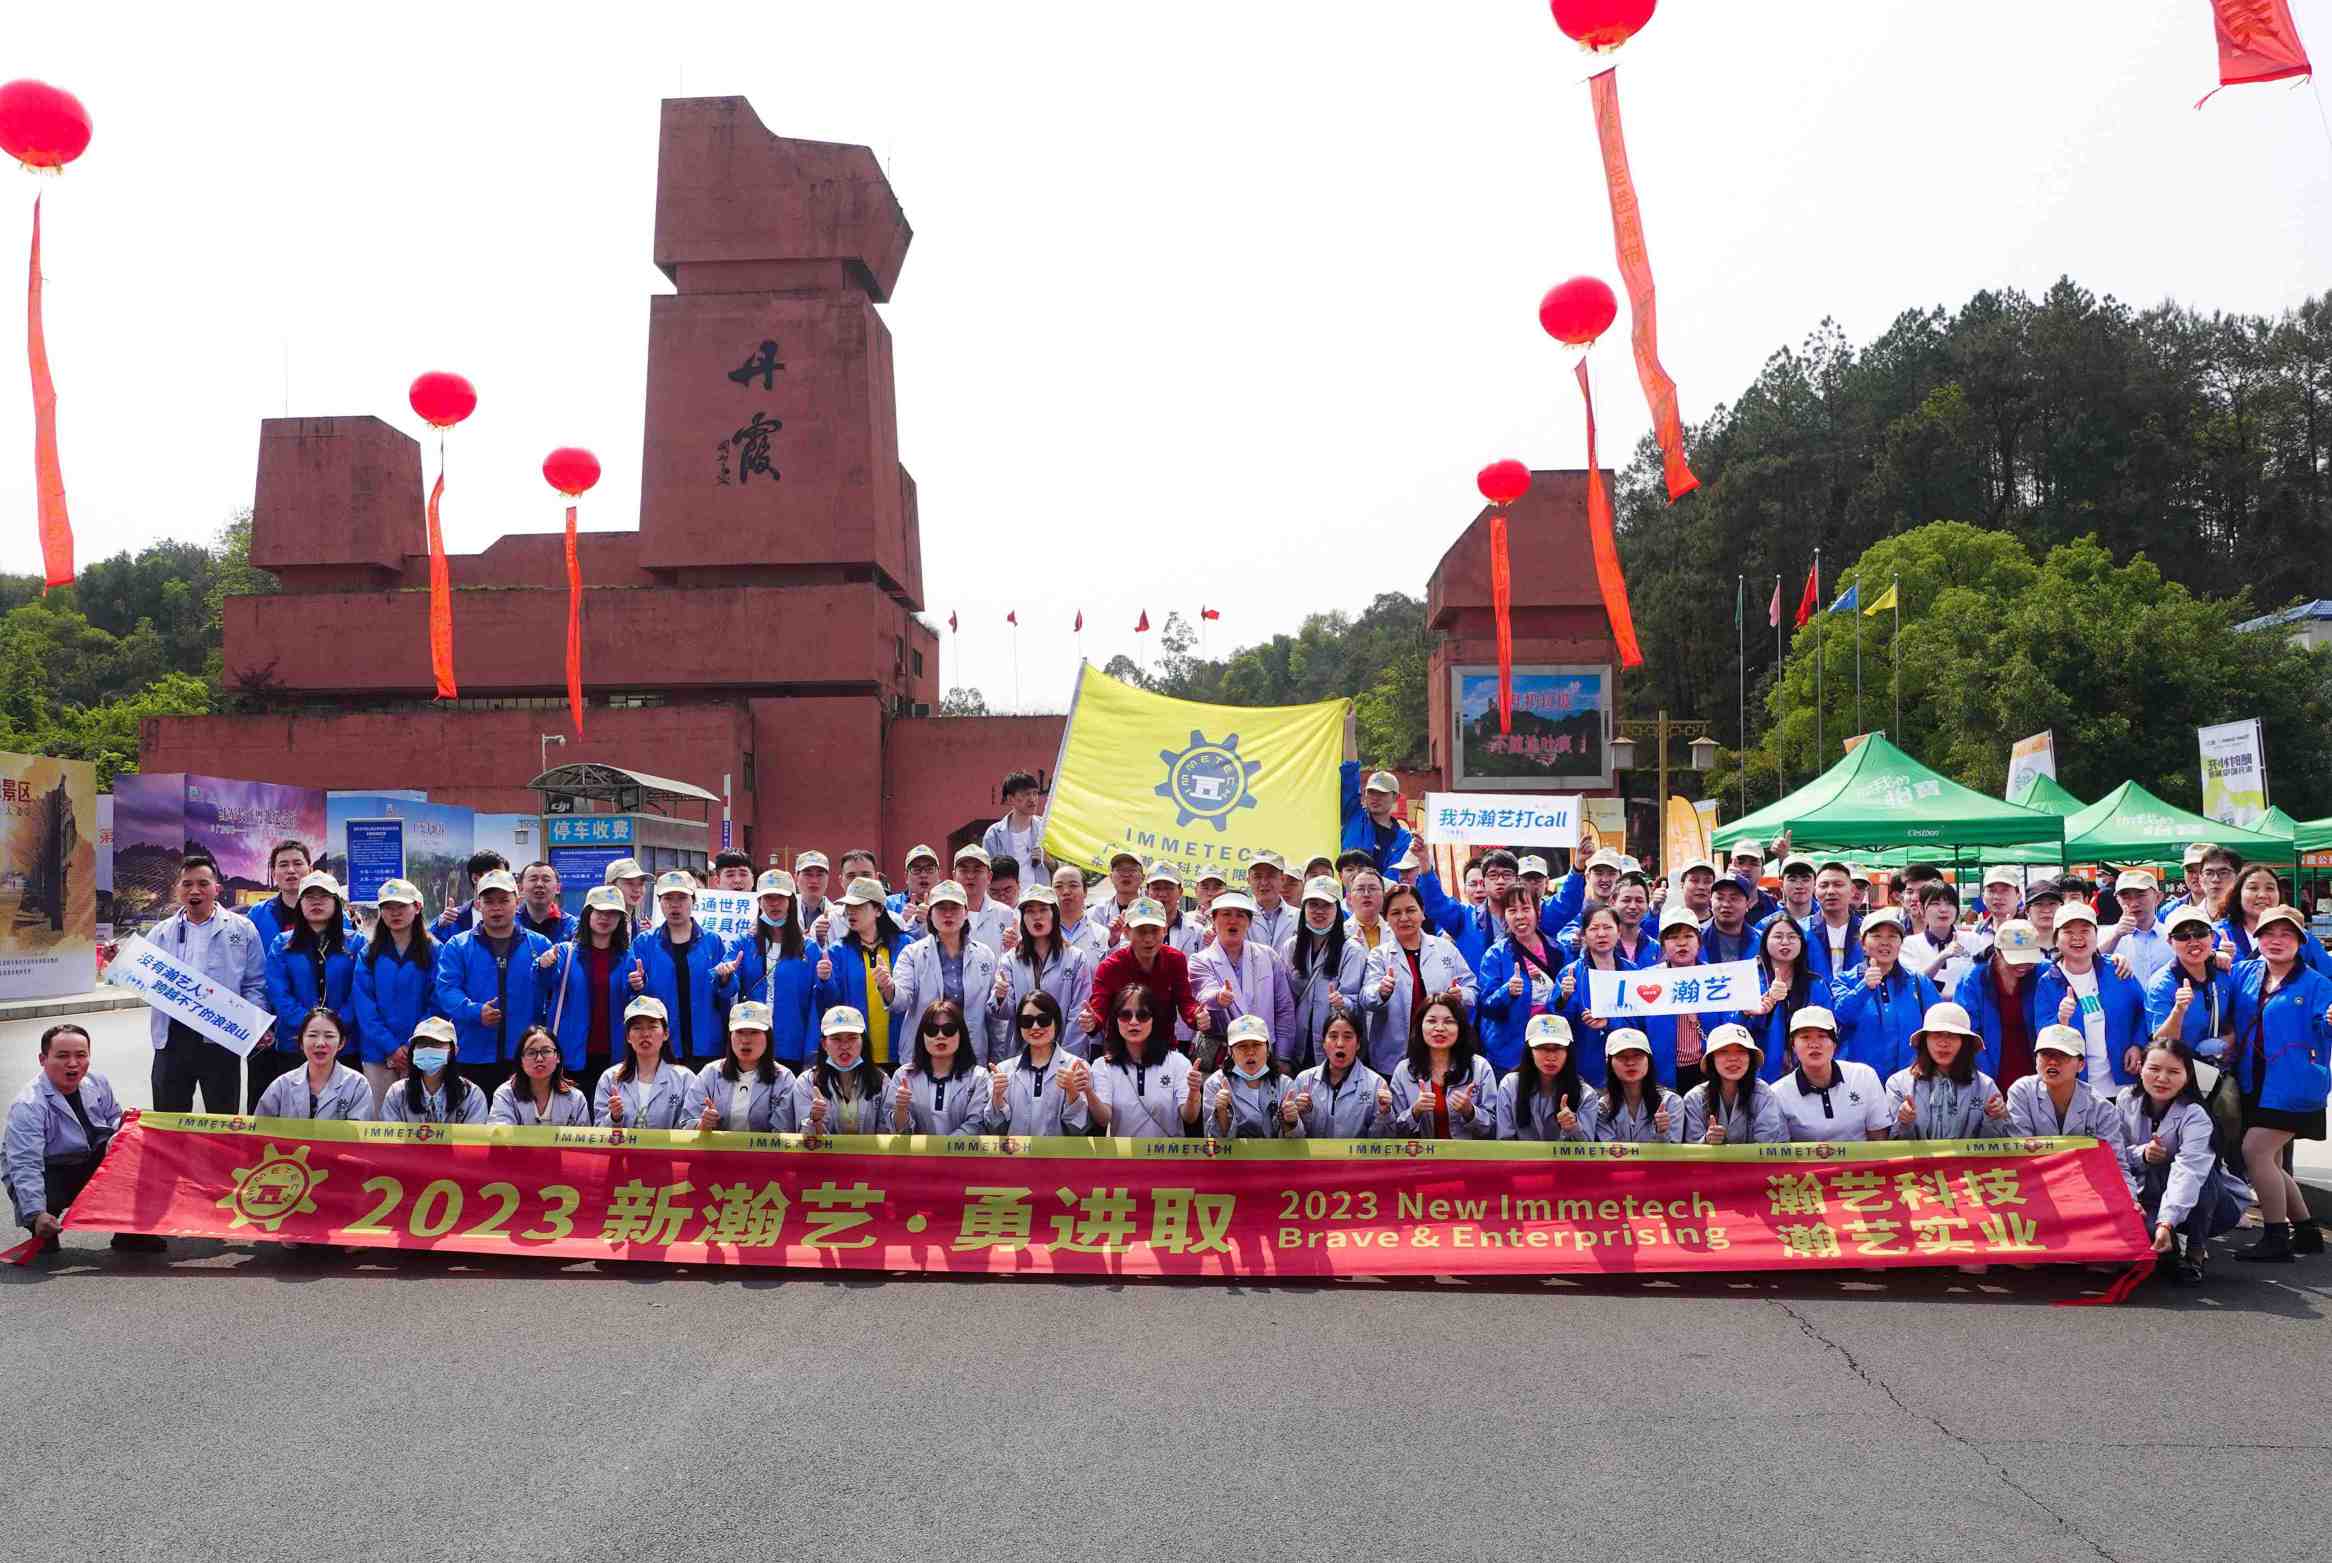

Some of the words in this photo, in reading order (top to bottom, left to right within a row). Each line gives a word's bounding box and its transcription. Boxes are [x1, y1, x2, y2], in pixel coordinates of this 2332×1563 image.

[0, 778, 32, 802] 景区
[554, 820, 629, 841] 停车收费
[1440, 807, 1568, 829] 我为瀚艺打call
[1126, 828, 1253, 862] IMMETEC
[1616, 979, 1627, 1008] I
[1671, 976, 1732, 1004] 瀚艺
[152, 979, 250, 1041] 跨越不了的浪浪山
[341, 1176, 580, 1240] 2023
[1278, 1190, 1379, 1221] 2023
[1397, 1192, 1489, 1221] New
[1500, 1191, 1717, 1221] Immetech
[1766, 1168, 2028, 1216] 瀚艺科技
[1278, 1226, 1399, 1249] Brave
[1410, 1226, 1440, 1250] &
[1453, 1223, 1731, 1252] Enterprising
[1777, 1212, 2048, 1258] 瀚艺实业
